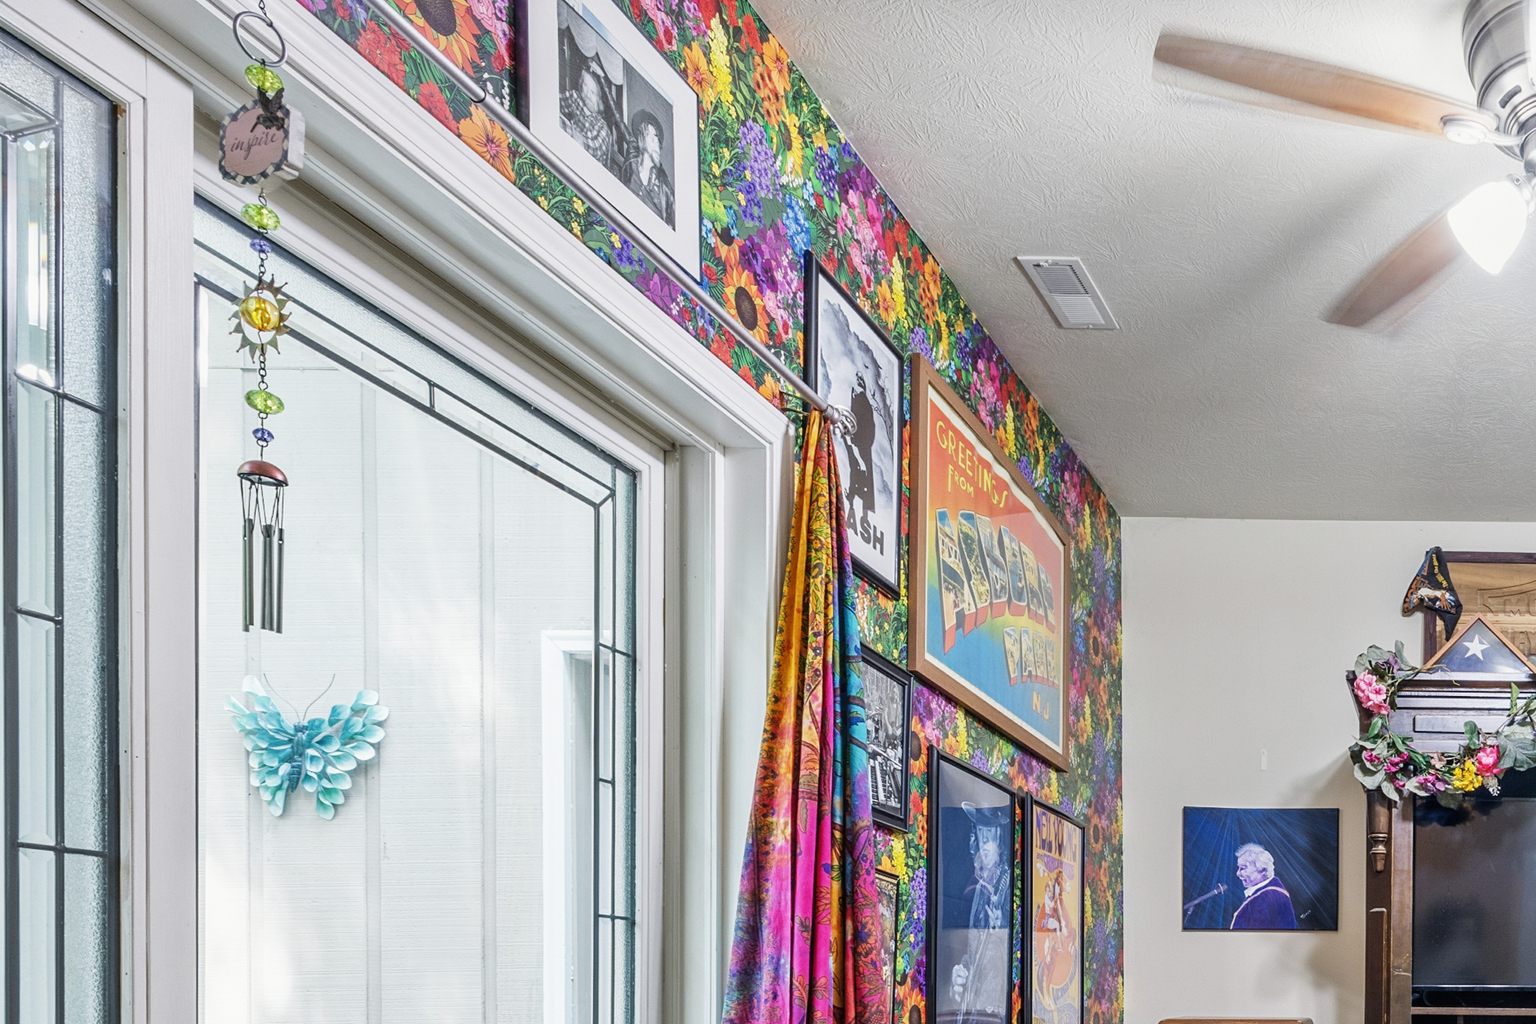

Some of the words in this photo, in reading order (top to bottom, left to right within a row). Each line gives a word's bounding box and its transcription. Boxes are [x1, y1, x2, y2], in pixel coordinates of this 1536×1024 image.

[230, 131, 278, 160] inspire
[936, 420, 1008, 508] GREETINGS
[948, 463, 975, 498] FROM
[846, 508, 884, 556] ASH
[1003, 626, 1059, 688] PARK
